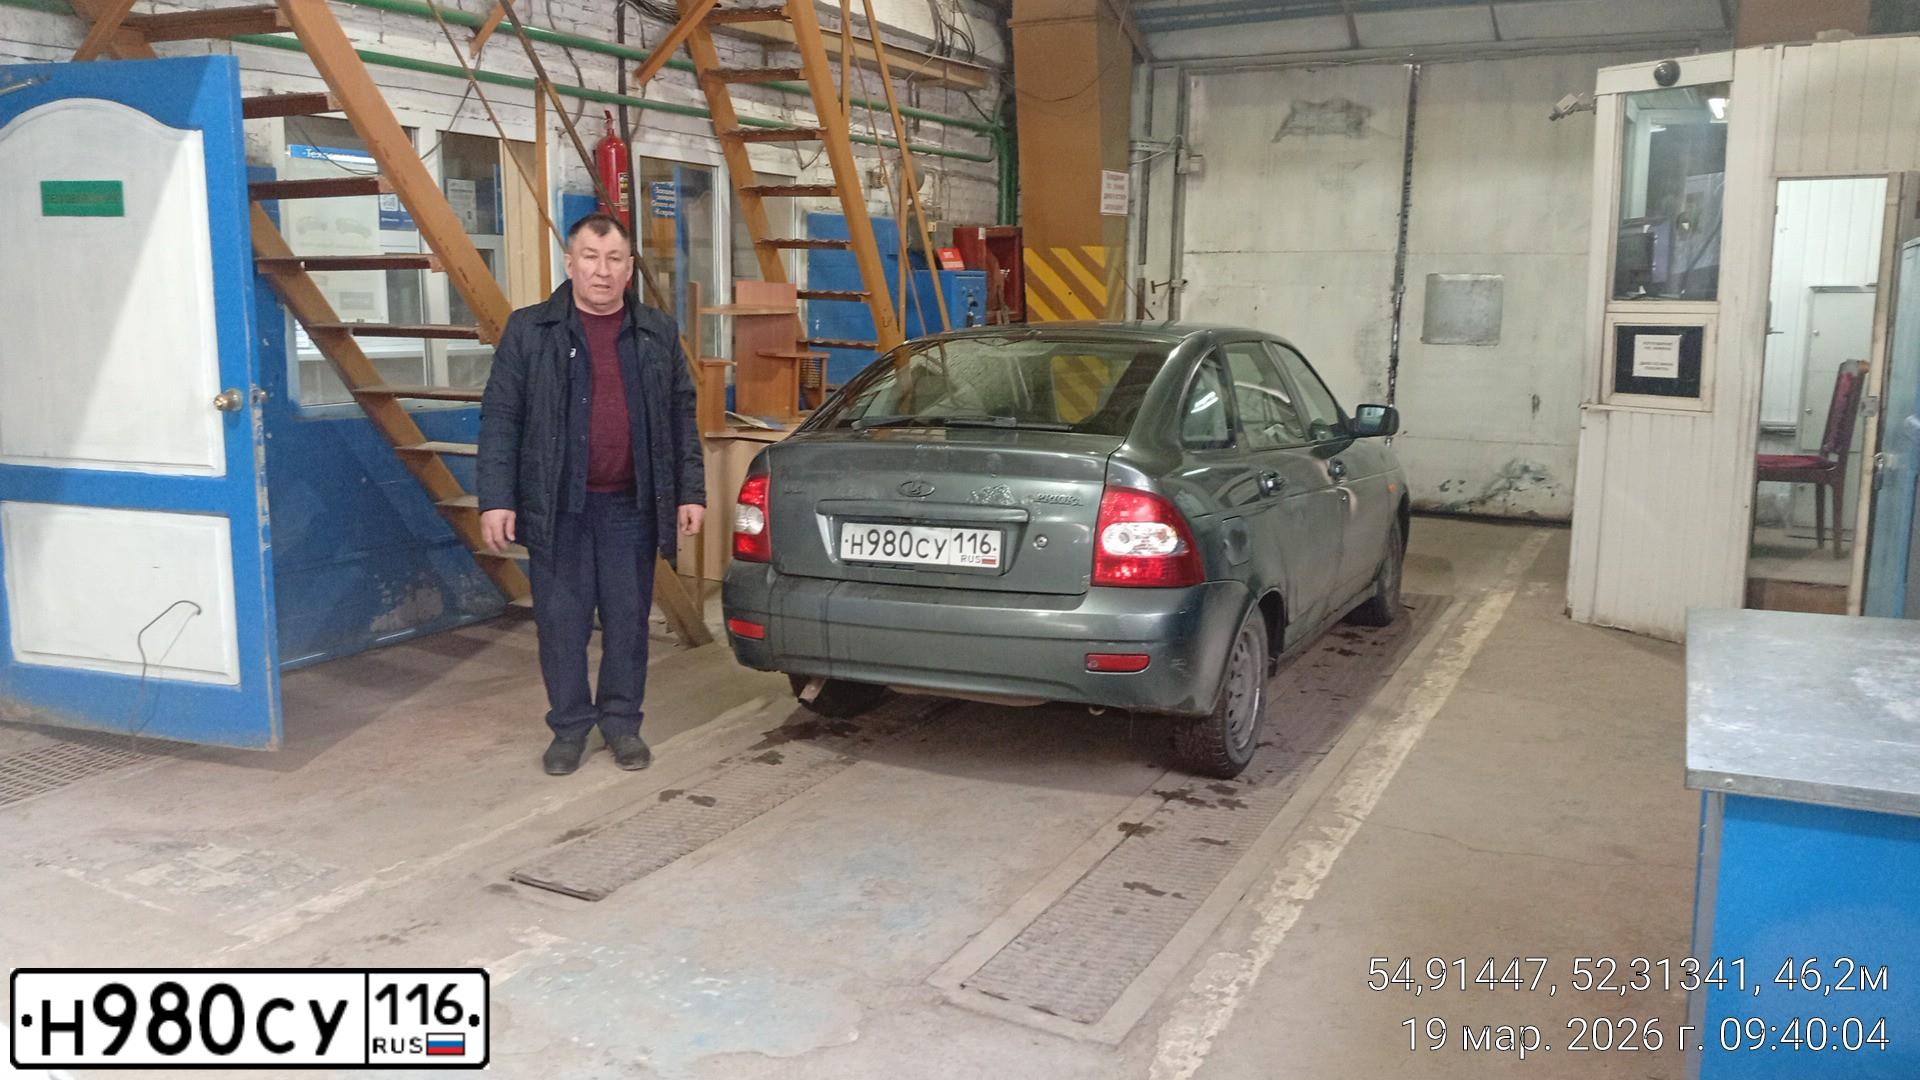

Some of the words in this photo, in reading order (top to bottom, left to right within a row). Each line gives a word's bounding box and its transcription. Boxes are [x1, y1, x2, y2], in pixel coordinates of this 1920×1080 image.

[850, 529, 948, 559] Н980СУ
[953, 532, 992, 555] 116
[960, 554, 981, 564] RUS
